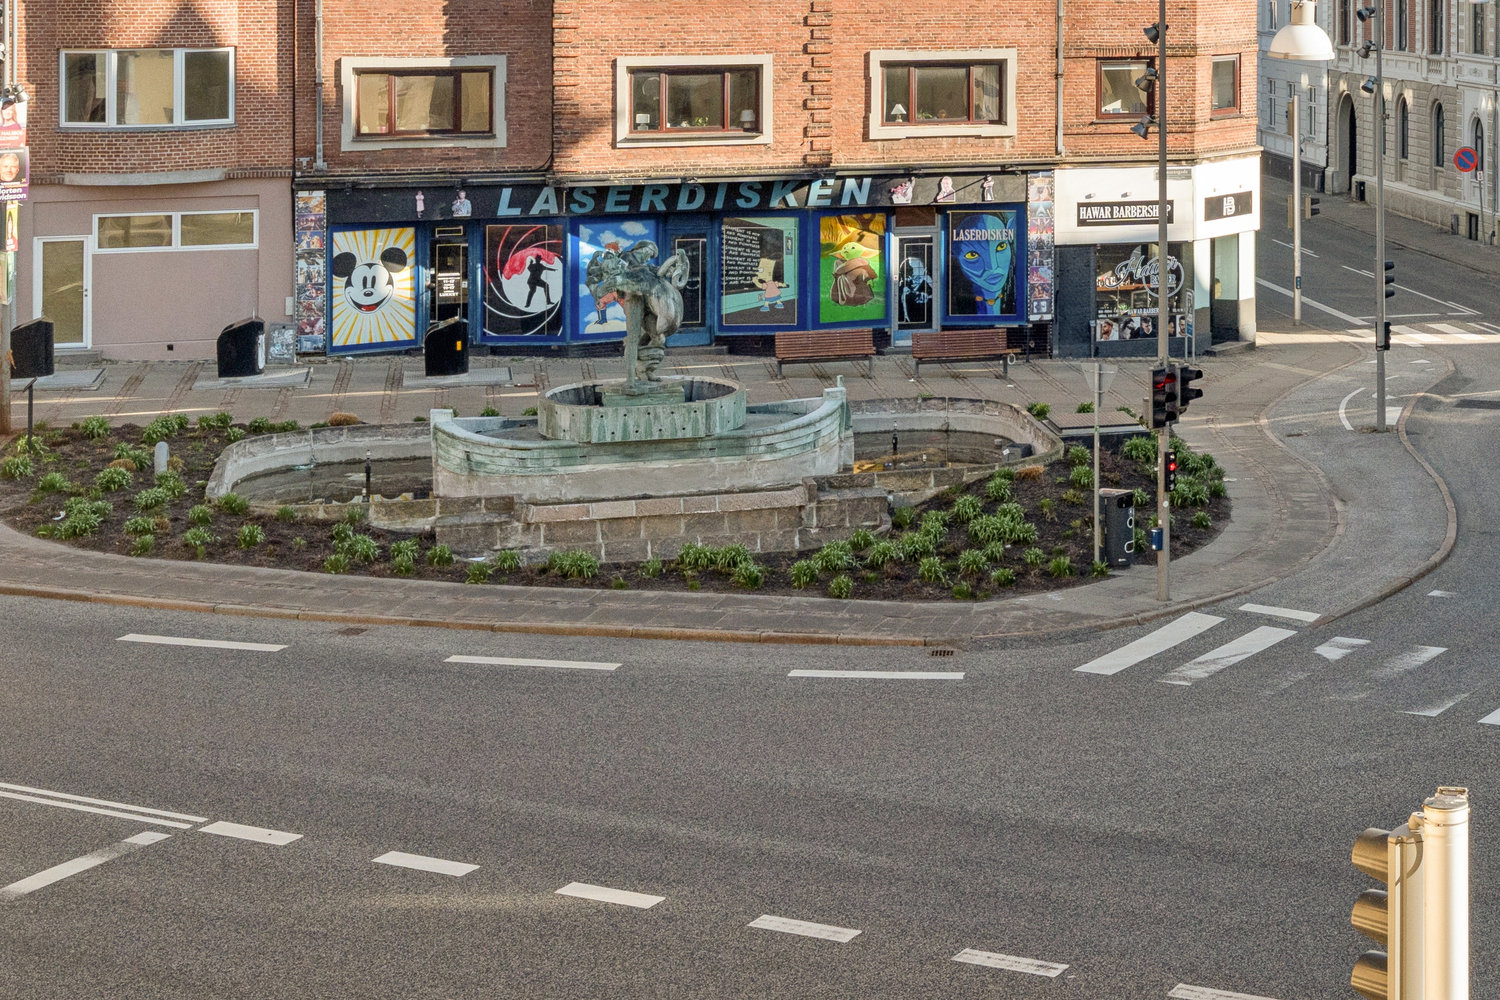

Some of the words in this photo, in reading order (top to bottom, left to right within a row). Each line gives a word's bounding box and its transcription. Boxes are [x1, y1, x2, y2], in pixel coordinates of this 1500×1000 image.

[496, 178, 872, 217] LASERDISKEN
[1079, 205, 1112, 220] HAWAR
[1113, 205, 1171, 219] BARBERSHP
[953, 228, 1014, 241] LASERDISKEN
